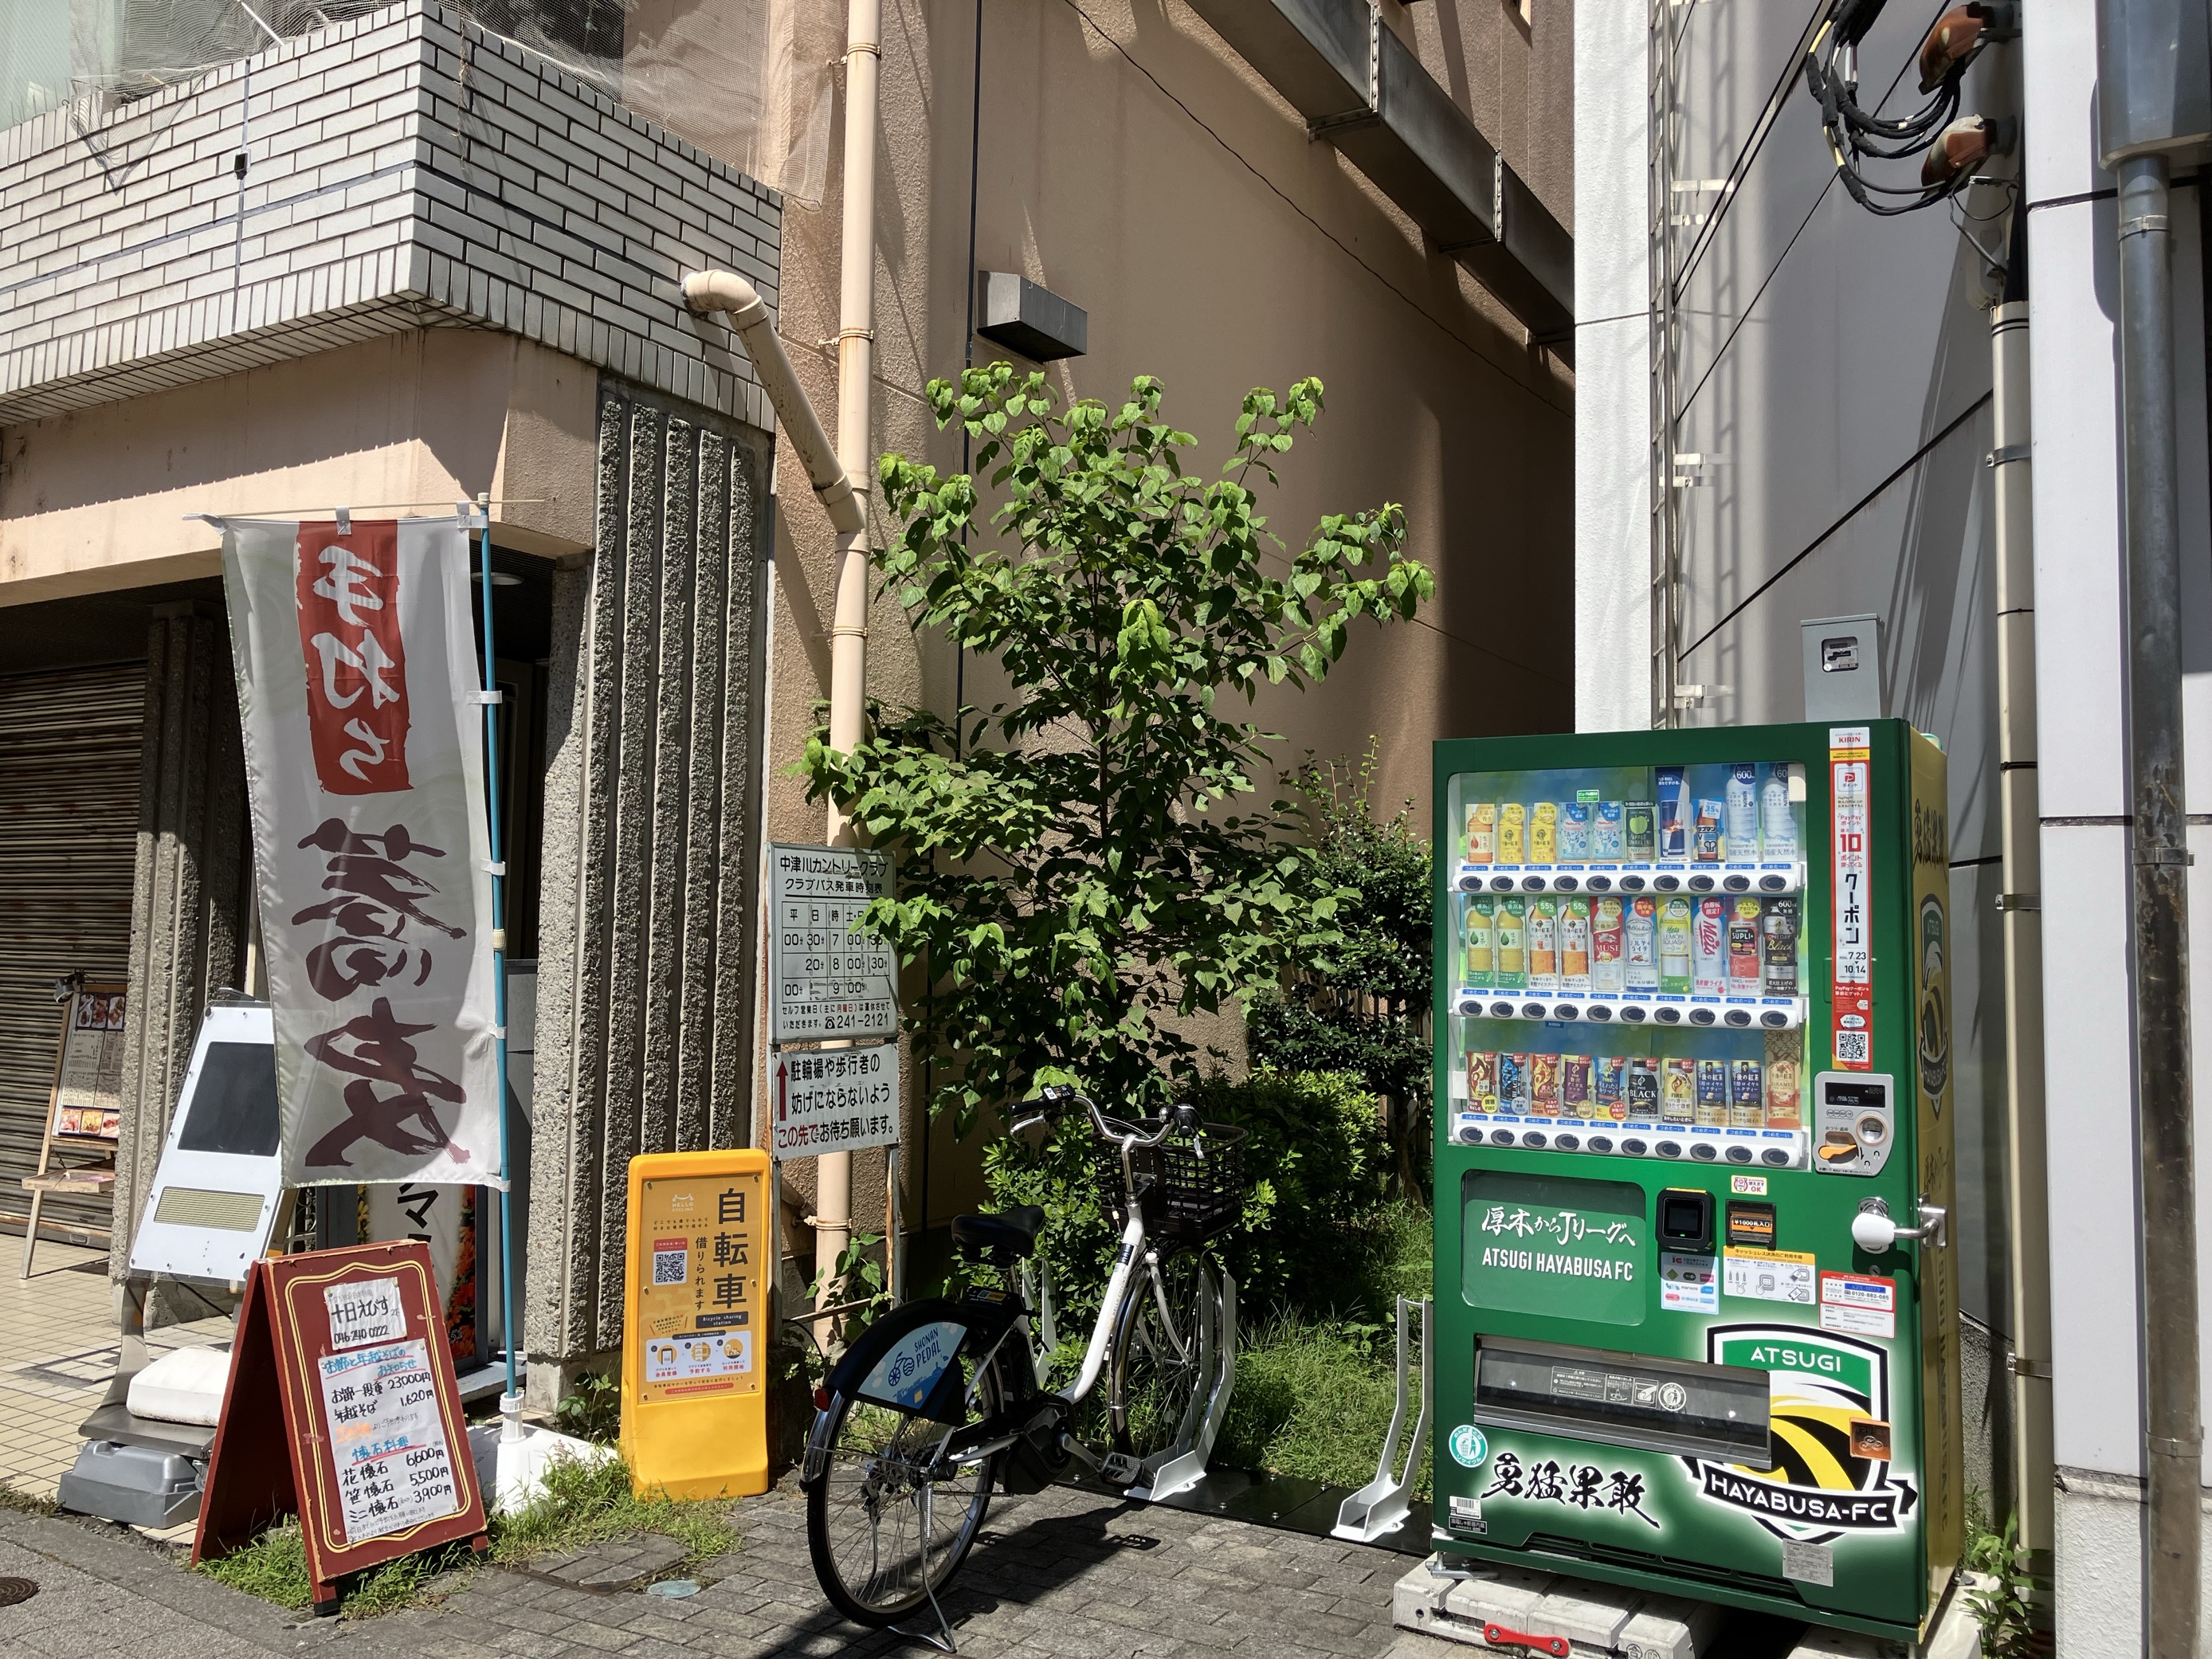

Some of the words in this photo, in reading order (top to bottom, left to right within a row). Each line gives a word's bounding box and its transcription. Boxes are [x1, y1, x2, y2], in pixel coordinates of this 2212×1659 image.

[1840, 833, 1861, 853] 10
[780, 855, 888, 877] 中津川カントリークラブ
[785, 878, 883, 894] クラブバス発車時刻表
[831, 910, 839, 922] 時
[1844, 873, 1860, 944] クーポン
[833, 934, 838, 946] 7
[1702, 920, 1720, 955] Mets
[1767, 939, 1793, 951] Black
[833, 958, 839, 970] 8
[1848, 951, 1866, 960] 7.23
[1845, 965, 1866, 974] 10.14
[833, 982, 839, 994] 9
[790, 1053, 880, 1082] 駐輪場や歩行者の
[791, 1082, 890, 1116] 妨げにならないよう
[1630, 1089, 1657, 1098] BLACK
[778, 1114, 893, 1149] この先でお待ち願います。
[1481, 1206, 1636, 1247] 厚木からJリーグへ
[712, 1187, 749, 1310] 自転車
[1735, 1249, 1803, 1260] キャッシュレス決済のご利用手順
[695, 1236, 708, 1312] 借りられます
[1481, 1247, 1532, 1271] ATSUGI
[1535, 1252, 1613, 1280] HAYABUSA
[1614, 1261, 1634, 1282] FC
[331, 1295, 388, 1324] 十日えびす
[914, 1327, 939, 1352] SHONAN
[326, 1346, 406, 1375] お節と年越そばの
[916, 1340, 942, 1368] PEDAL
[1750, 1346, 1841, 1372] ATSUGI
[377, 1359, 417, 1377] お知らせ
[334, 1399, 378, 1424] 年越そば
[400, 1389, 434, 1406] 1,620円
[351, 1436, 409, 1462] 懐石料理
[1457, 1453, 1482, 1465] リサイクル
[1481, 1452, 1661, 1529] 勇猛果敢
[1711, 1473, 1888, 1521] HAYABUSA-FC
